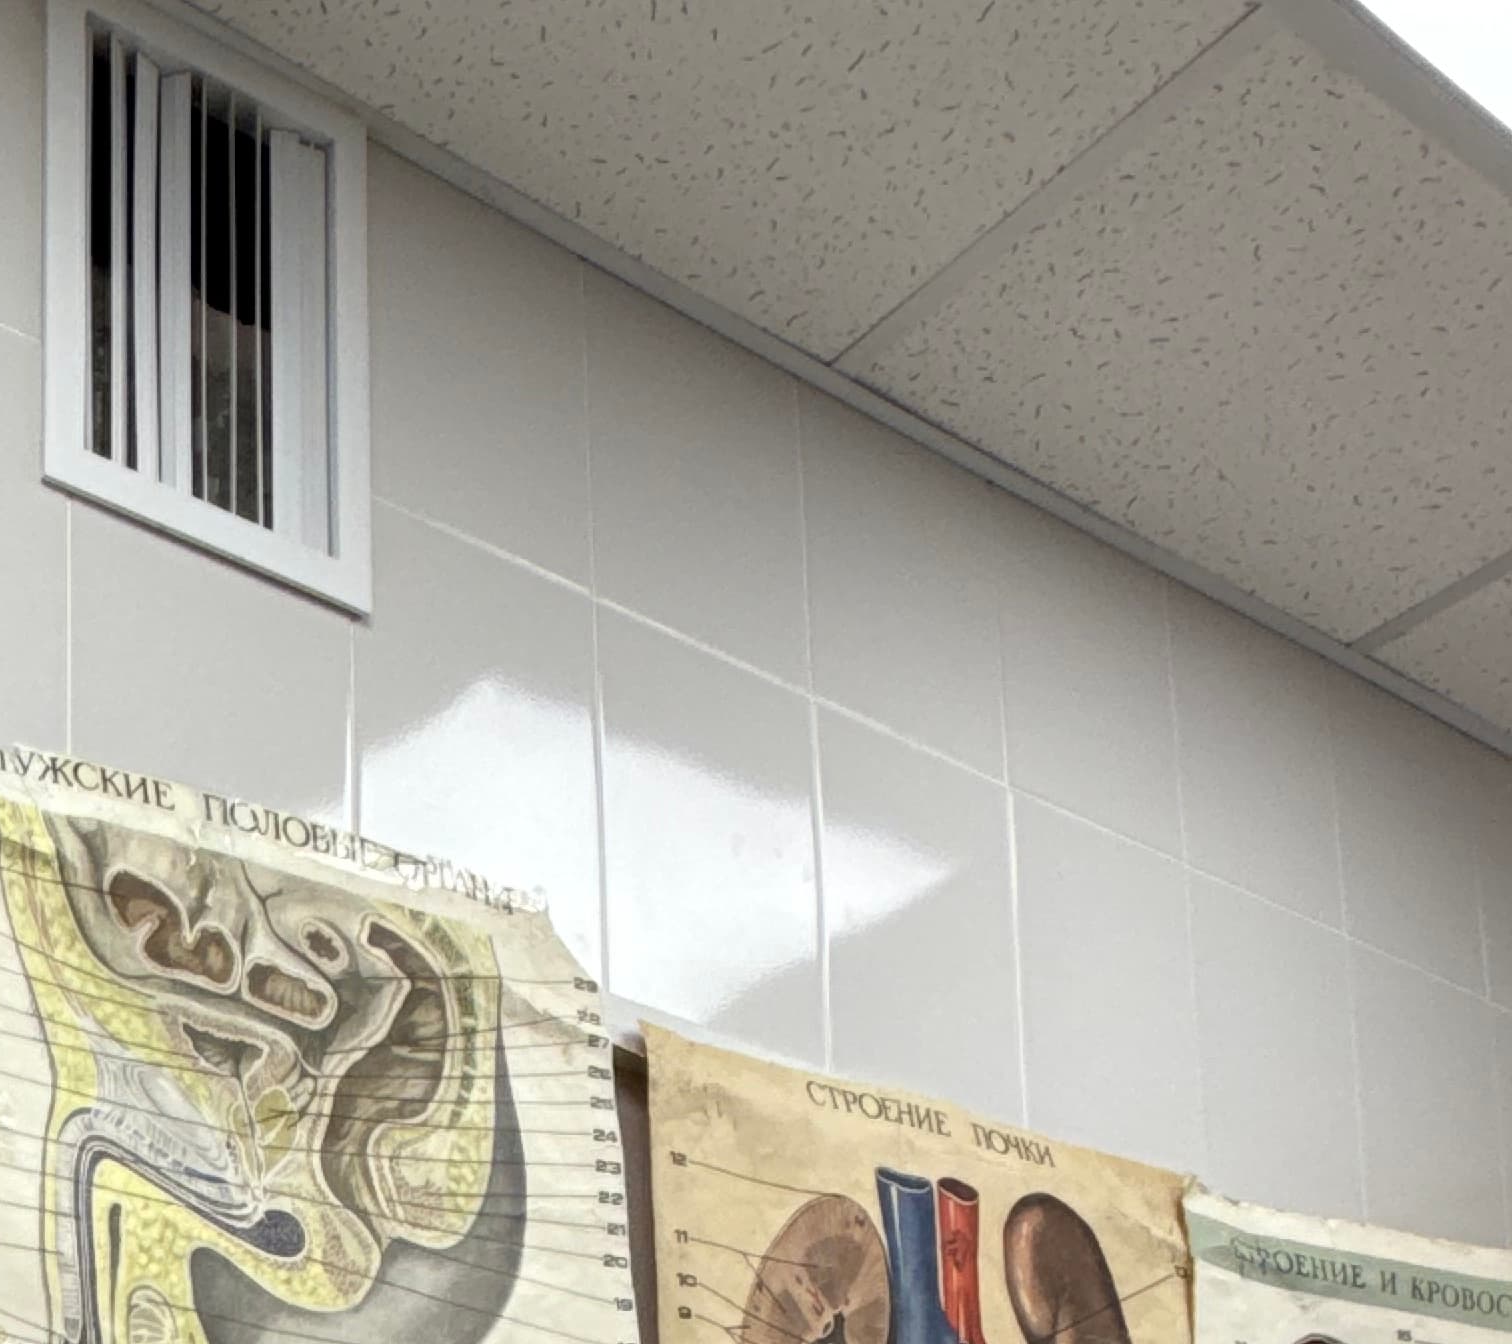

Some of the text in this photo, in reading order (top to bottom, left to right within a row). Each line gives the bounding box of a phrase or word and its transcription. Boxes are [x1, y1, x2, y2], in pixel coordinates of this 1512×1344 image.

[806, 1080, 1055, 1167] СТРОЕНИЕ ПОЧКИ
[592, 1128, 618, 1143] 24
[670, 1151, 687, 1166] 12
[598, 1191, 624, 1206] 22
[675, 1229, 688, 1243] 11
[603, 1254, 628, 1269] 20
[677, 1272, 697, 1287] 10
[1380, 1270, 1397, 1295] И
